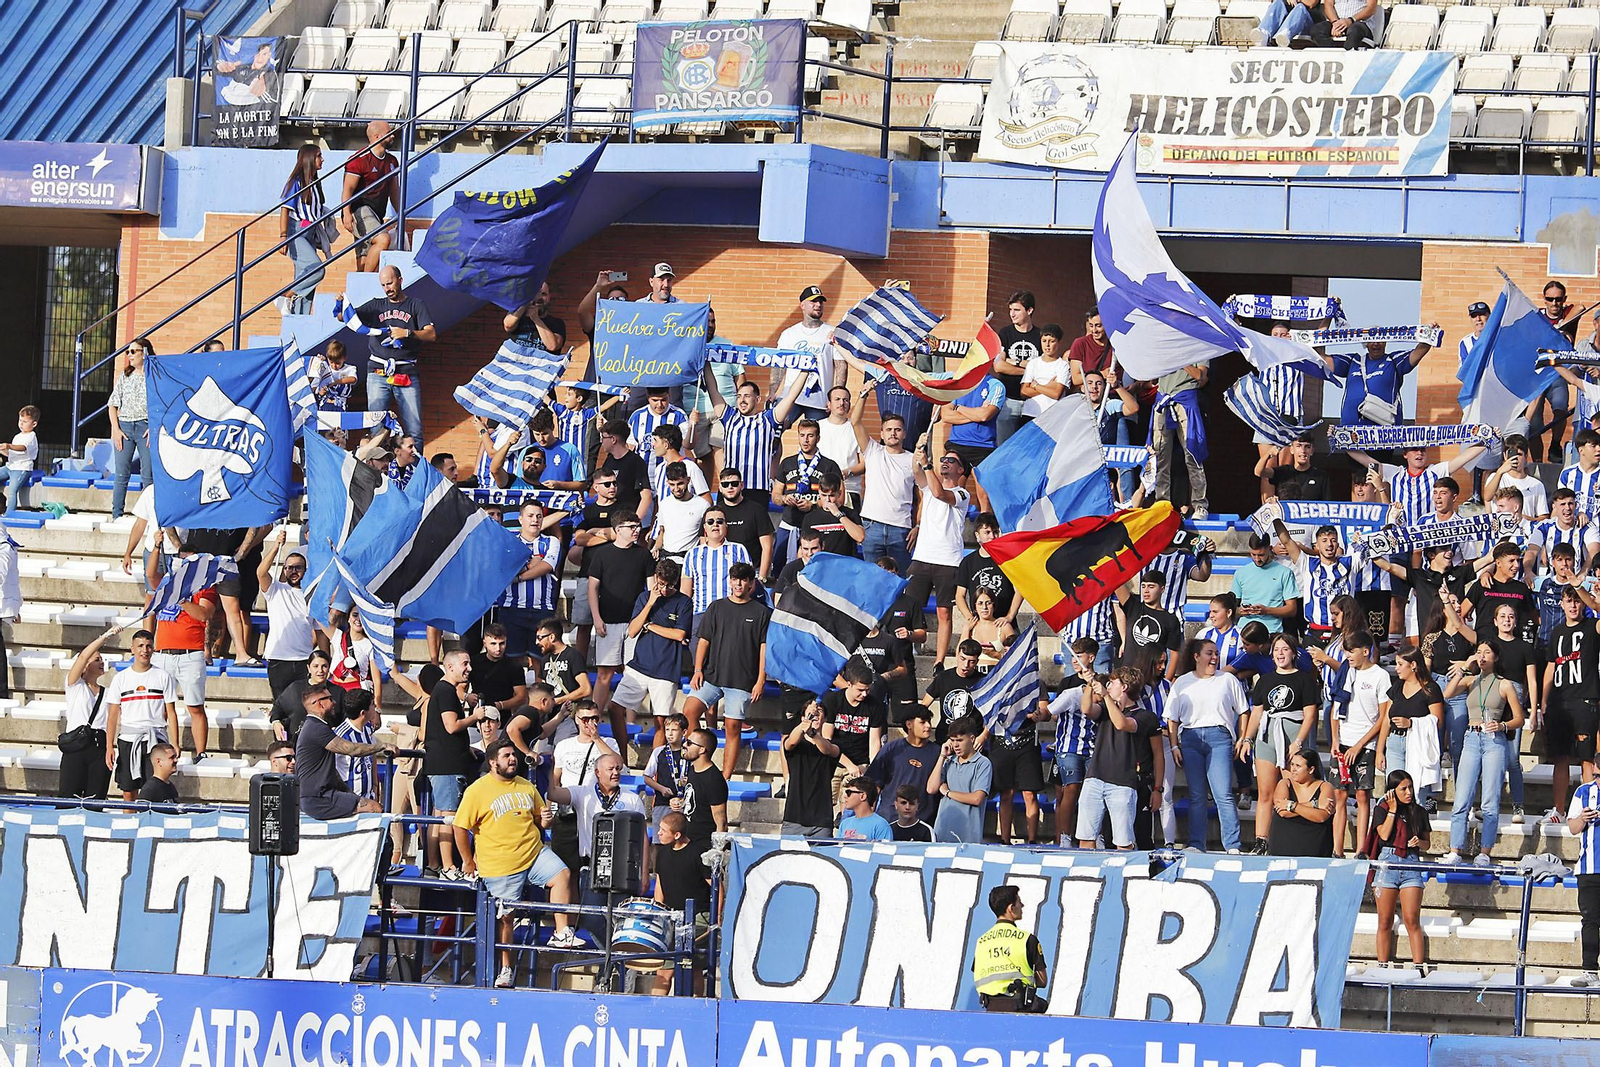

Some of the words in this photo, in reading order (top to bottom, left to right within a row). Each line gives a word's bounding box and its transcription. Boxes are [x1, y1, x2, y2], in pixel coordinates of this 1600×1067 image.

[670, 24, 764, 43] PELOTÓN
[1229, 60, 1344, 85] SECTOR
[655, 85, 773, 112] PANSARCÓ
[219, 112, 230, 124] LA
[234, 110, 271, 123] MORTE
[1123, 88, 1435, 138] HELICÓSTERO
[241, 126, 254, 138] LA
[1005, 134, 1032, 144] Sector
[1048, 147, 1068, 159] Gol
[1071, 141, 1089, 155] Sur
[1172, 149, 1230, 162] DECANO
[1235, 149, 1260, 162] DEL
[32, 160, 80, 180] alter
[31, 181, 115, 198] enersun
[595, 308, 653, 335] Huelva
[657, 312, 706, 338] Fans
[939, 339, 971, 355] ONU
[594, 341, 682, 385] Hooligans
[174, 411, 266, 465] ULTRAS
[1378, 427, 1425, 444] RECREATIVO
[1426, 426, 1436, 440] de
[1436, 424, 1467, 440] HUELVA
[1286, 502, 1383, 521] RECREATIVO
[1420, 518, 1473, 532] PRIMERA
[1423, 523, 1489, 541] RECREATIVO
[1433, 534, 1475, 546] HUELVA
[490, 792, 516, 822] TOMMY
[0, 827, 386, 981] NTE
